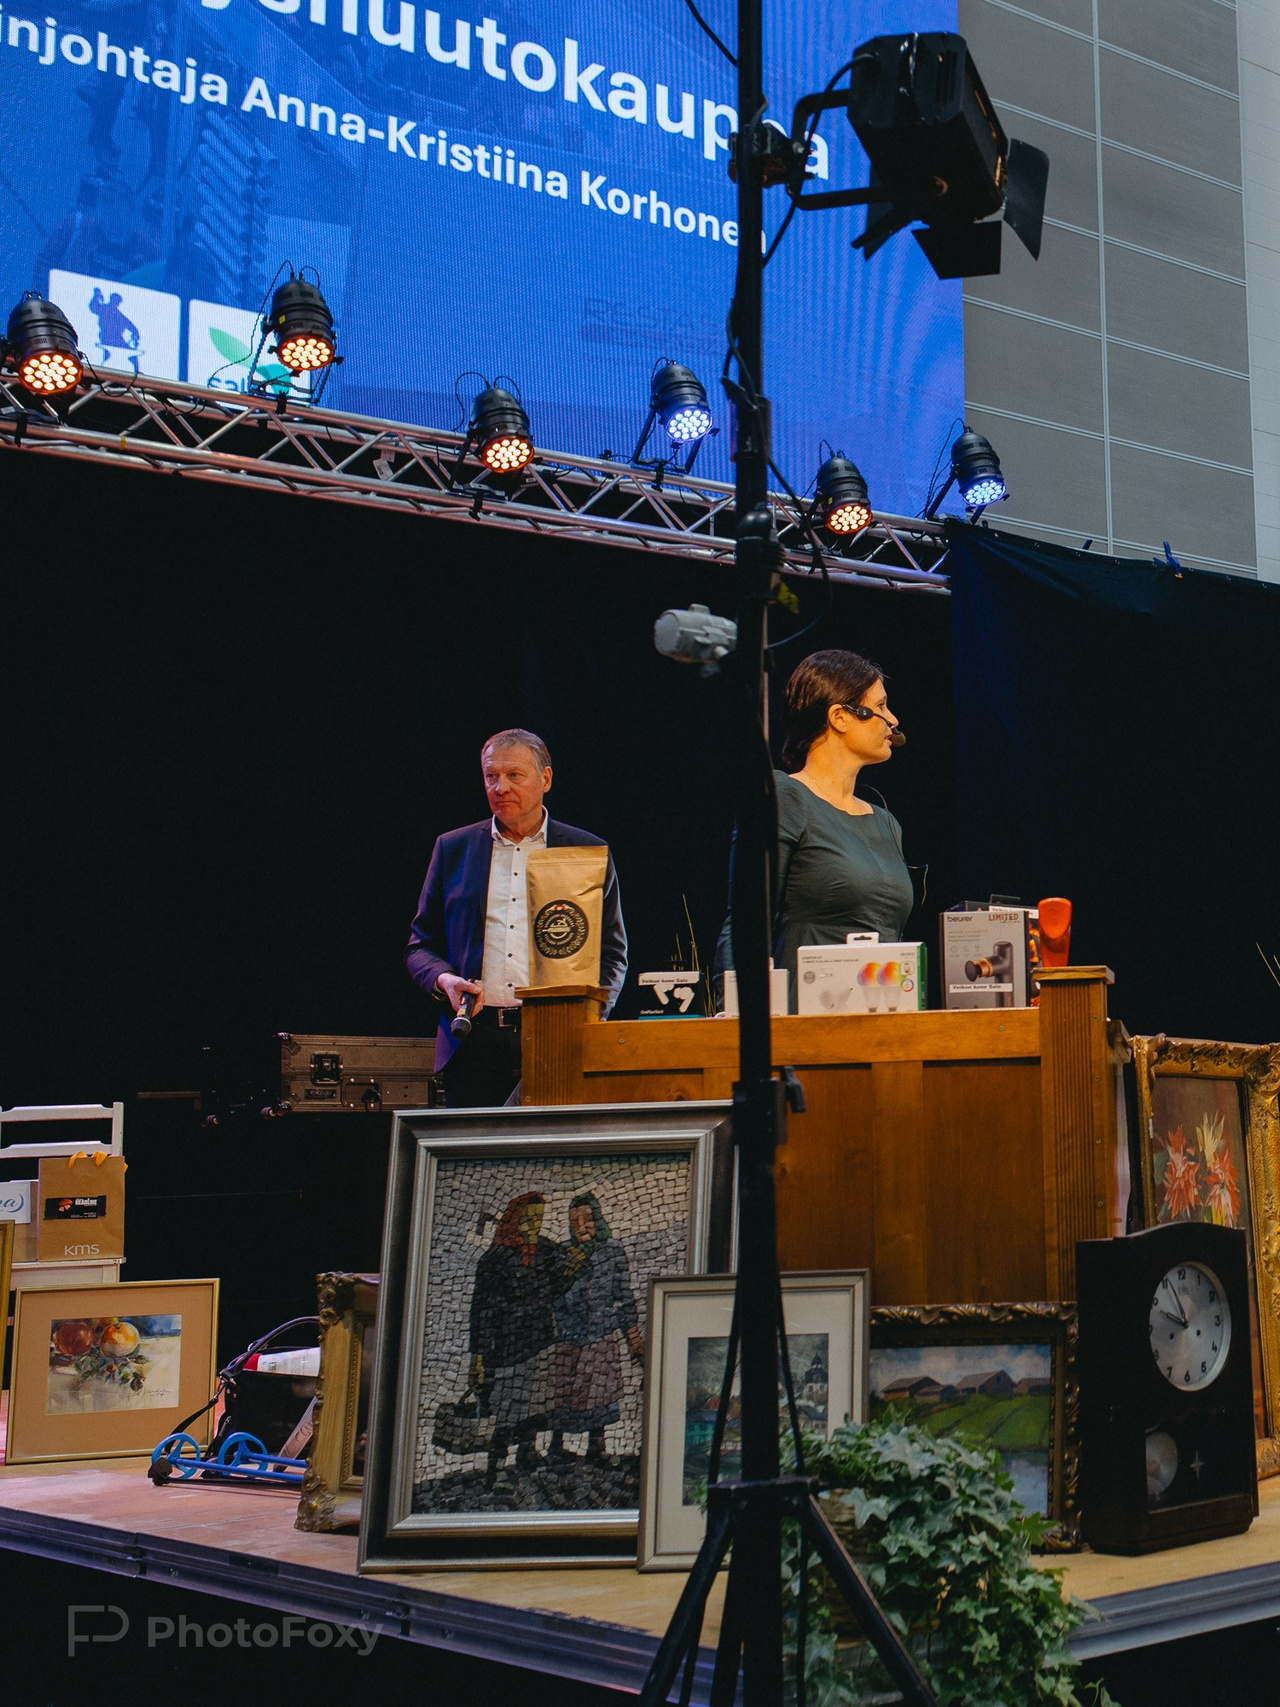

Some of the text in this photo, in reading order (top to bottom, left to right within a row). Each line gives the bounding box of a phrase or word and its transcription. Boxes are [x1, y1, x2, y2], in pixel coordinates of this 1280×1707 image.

[0, 3, 766, 254] njohtaja Anna-Kristiina Korhone
[988, 913, 1019, 922] LIMITED
